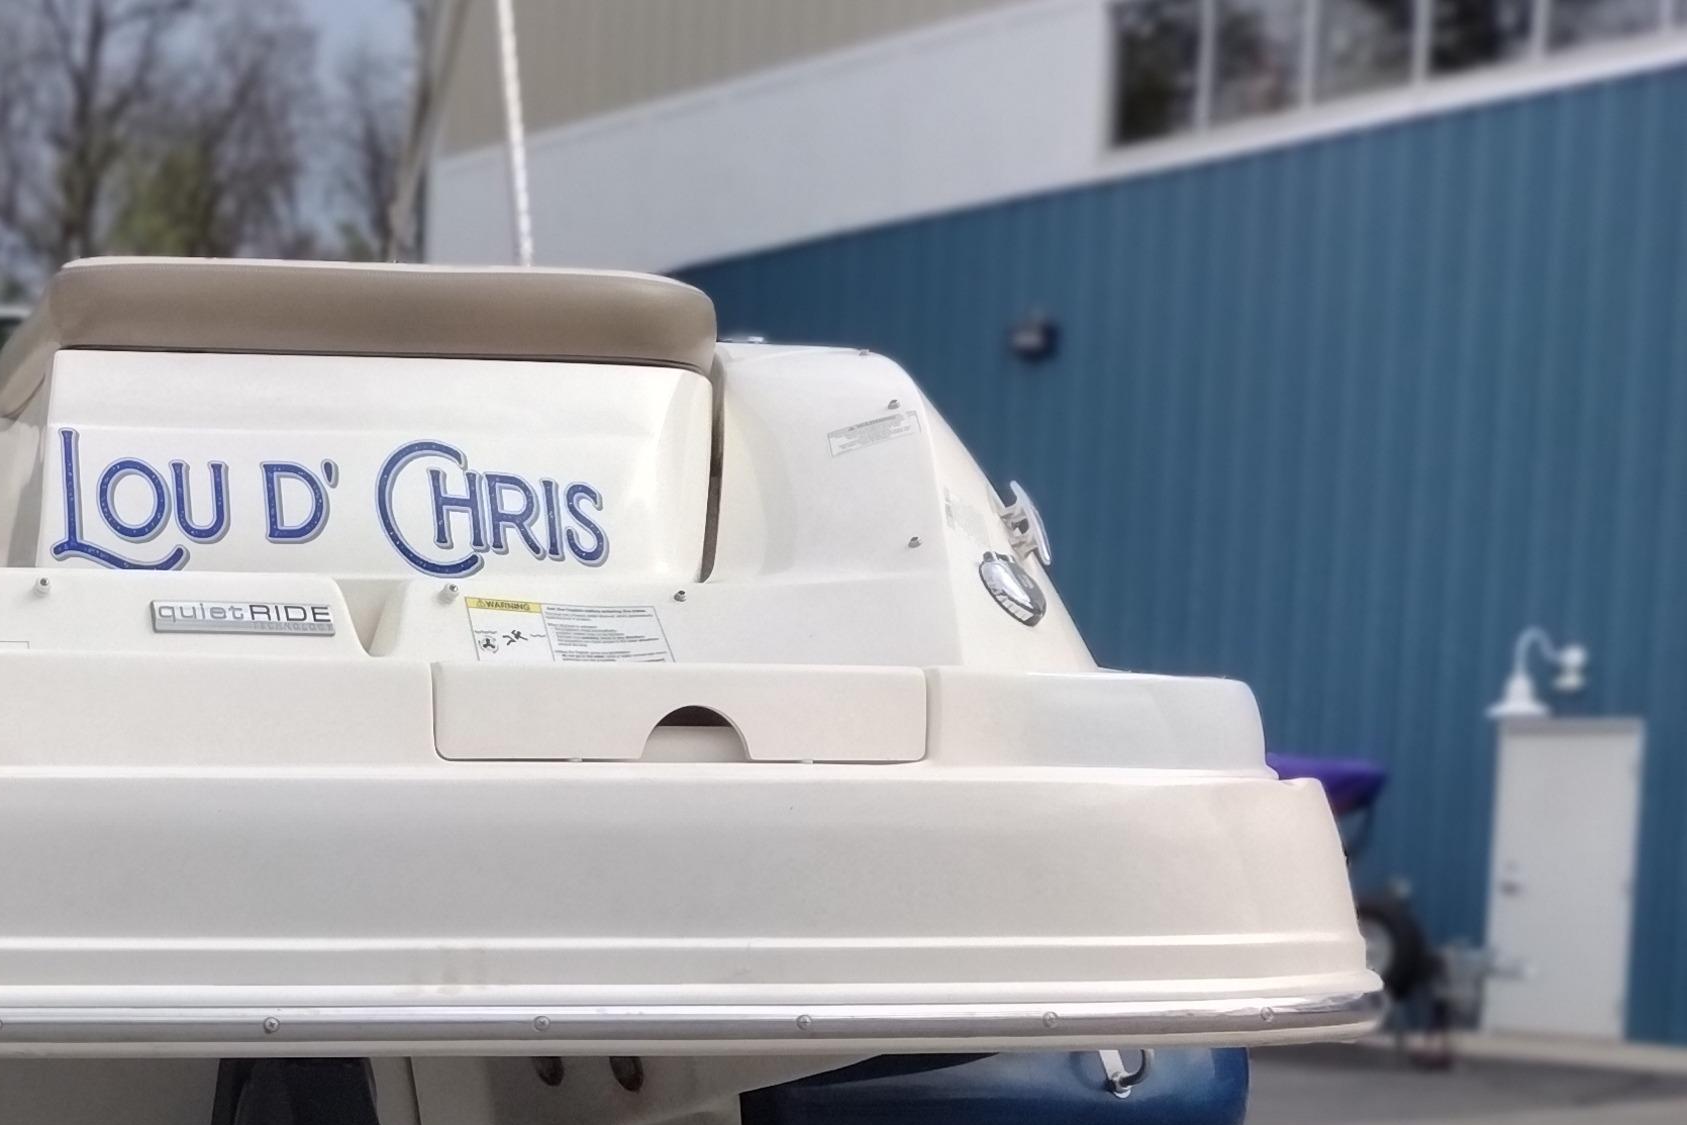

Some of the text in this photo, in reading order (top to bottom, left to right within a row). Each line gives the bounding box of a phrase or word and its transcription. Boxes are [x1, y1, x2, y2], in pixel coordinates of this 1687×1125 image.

[51, 427, 609, 578] LOU D' CHRIS
[485, 600, 531, 611] WARNING
